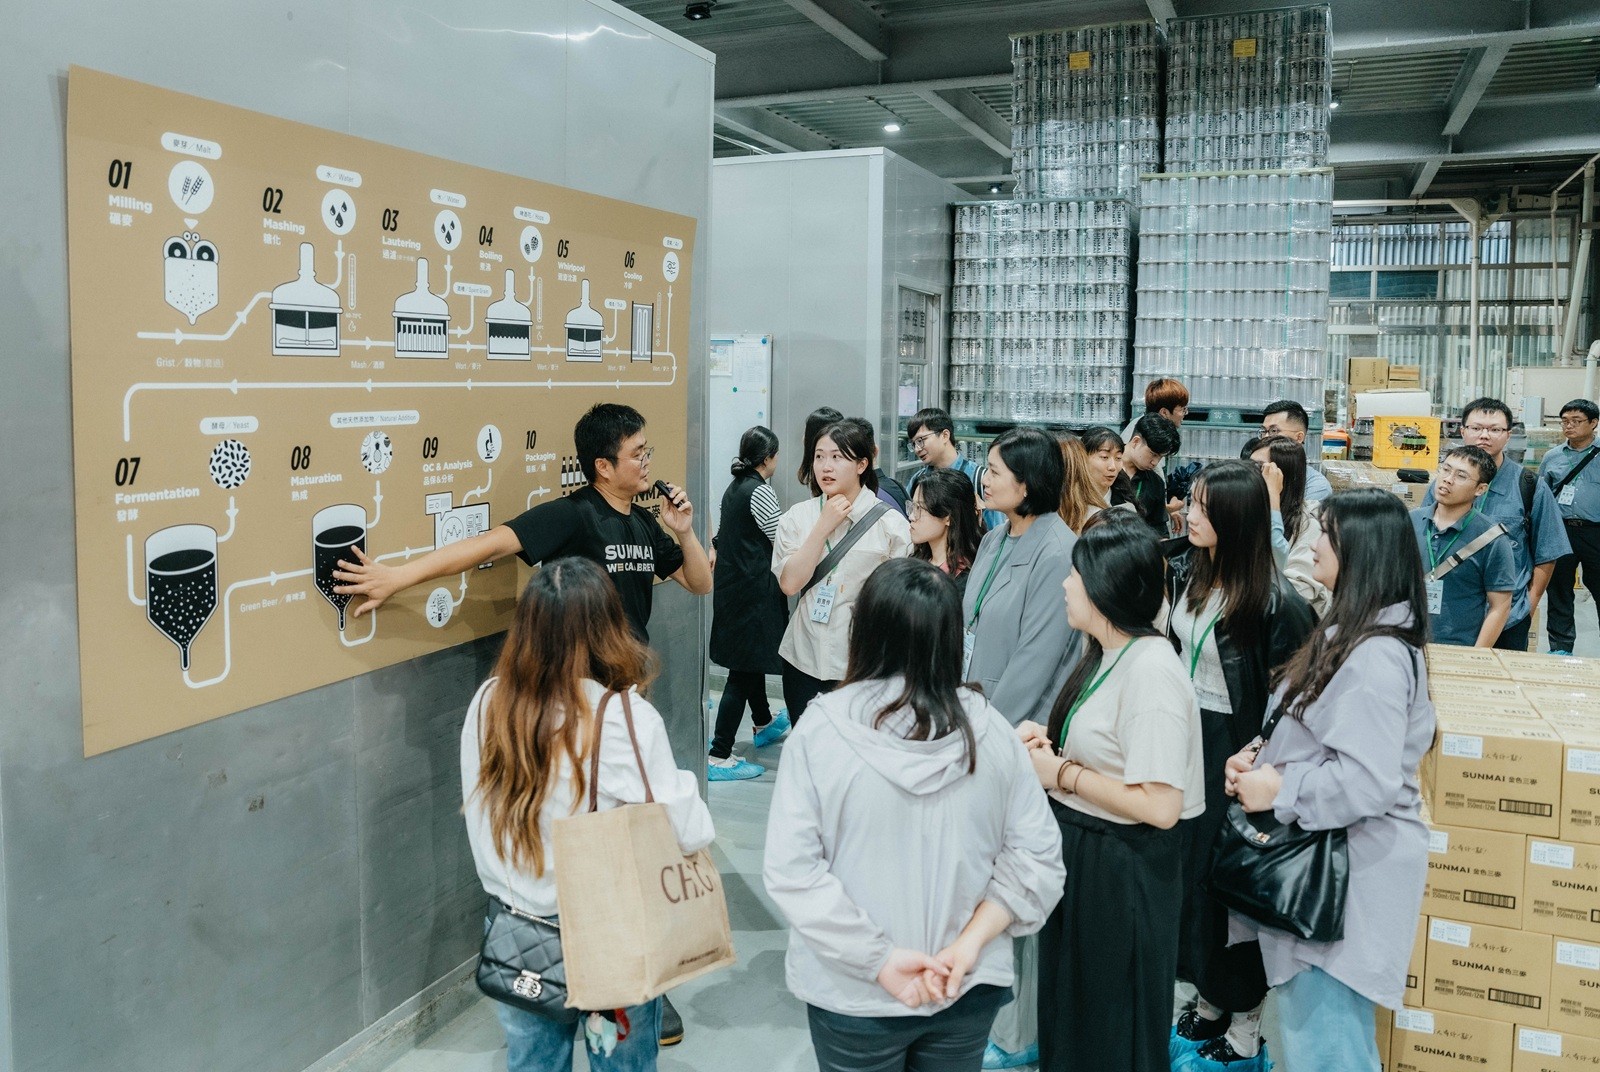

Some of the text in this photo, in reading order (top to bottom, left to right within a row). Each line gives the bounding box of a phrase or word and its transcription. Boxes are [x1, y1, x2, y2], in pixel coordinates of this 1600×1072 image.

[196, 143, 212, 154] Malt
[108, 159, 133, 189] 01
[108, 193, 154, 215] Milling
[262, 187, 284, 214] 02
[263, 217, 306, 235] Mashing
[382, 208, 400, 232] 03
[382, 234, 422, 252] Lautering
[479, 225, 494, 247] 04
[479, 250, 503, 263] Boiling
[557, 238, 570, 259] 05
[557, 261, 586, 273] Whirlpool
[624, 250, 637, 269] 06
[623, 271, 643, 282] Cooling
[156, 357, 176, 368] Grist
[350, 360, 368, 369] Mash
[233, 421, 250, 431] Yeast
[380, 415, 398, 423] Natural
[398, 414, 417, 422] Addition
[422, 436, 439, 459] 09
[526, 430, 537, 450] 10
[291, 445, 311, 471] 08
[525, 451, 556, 462] Packaging
[115, 457, 141, 487] 07
[423, 460, 473, 473] QC & Analysis
[290, 473, 343, 487] Maturation
[114, 488, 201, 505] Fermentation
[604, 544, 654, 561] SUNMAI
[240, 602, 261, 612] Green
[262, 599, 279, 608] Beer
[1462, 771, 1538, 785] SUNMAI 金色三麥
[1428, 861, 1502, 878] SUNMAI 金色三麥
[1552, 879, 1598, 892] SUNMAI
[1452, 959, 1527, 977] SUNMAI 金色三麥
[1579, 979, 1600, 989] SUN
[1414, 1044, 1488, 1064] SUNMAI 金色三麥
